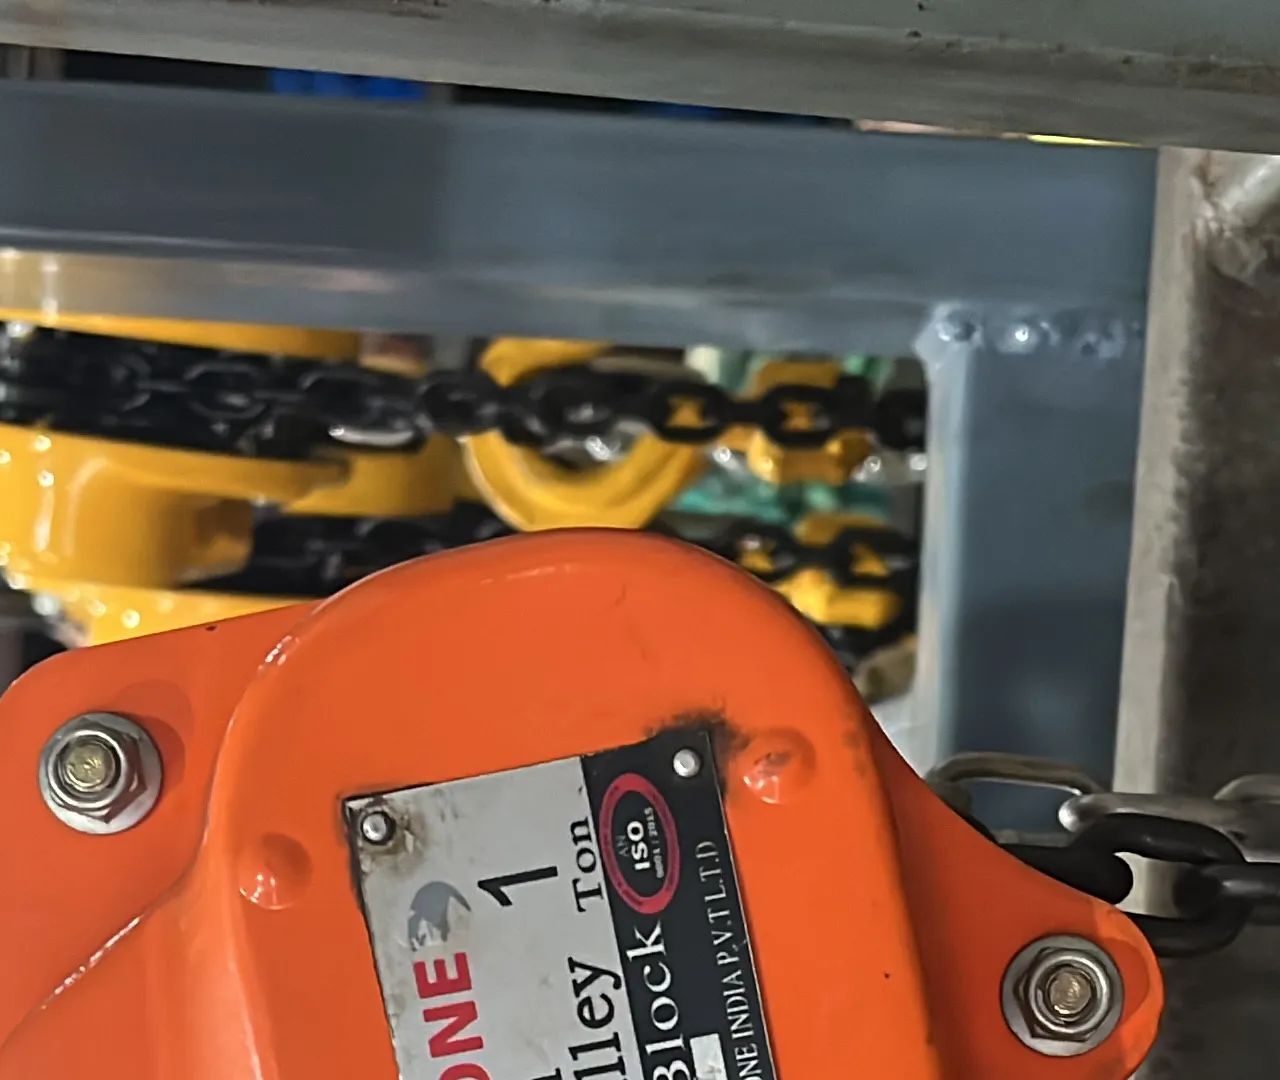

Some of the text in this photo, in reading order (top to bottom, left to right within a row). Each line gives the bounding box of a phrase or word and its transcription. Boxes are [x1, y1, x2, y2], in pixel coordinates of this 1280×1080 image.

[569, 816, 604, 913] Ton
[626, 820, 651, 871] ISO
[696, 841, 727, 902] L.T.D
[476, 865, 559, 908] 1
[721, 969, 755, 1040] INDIA
